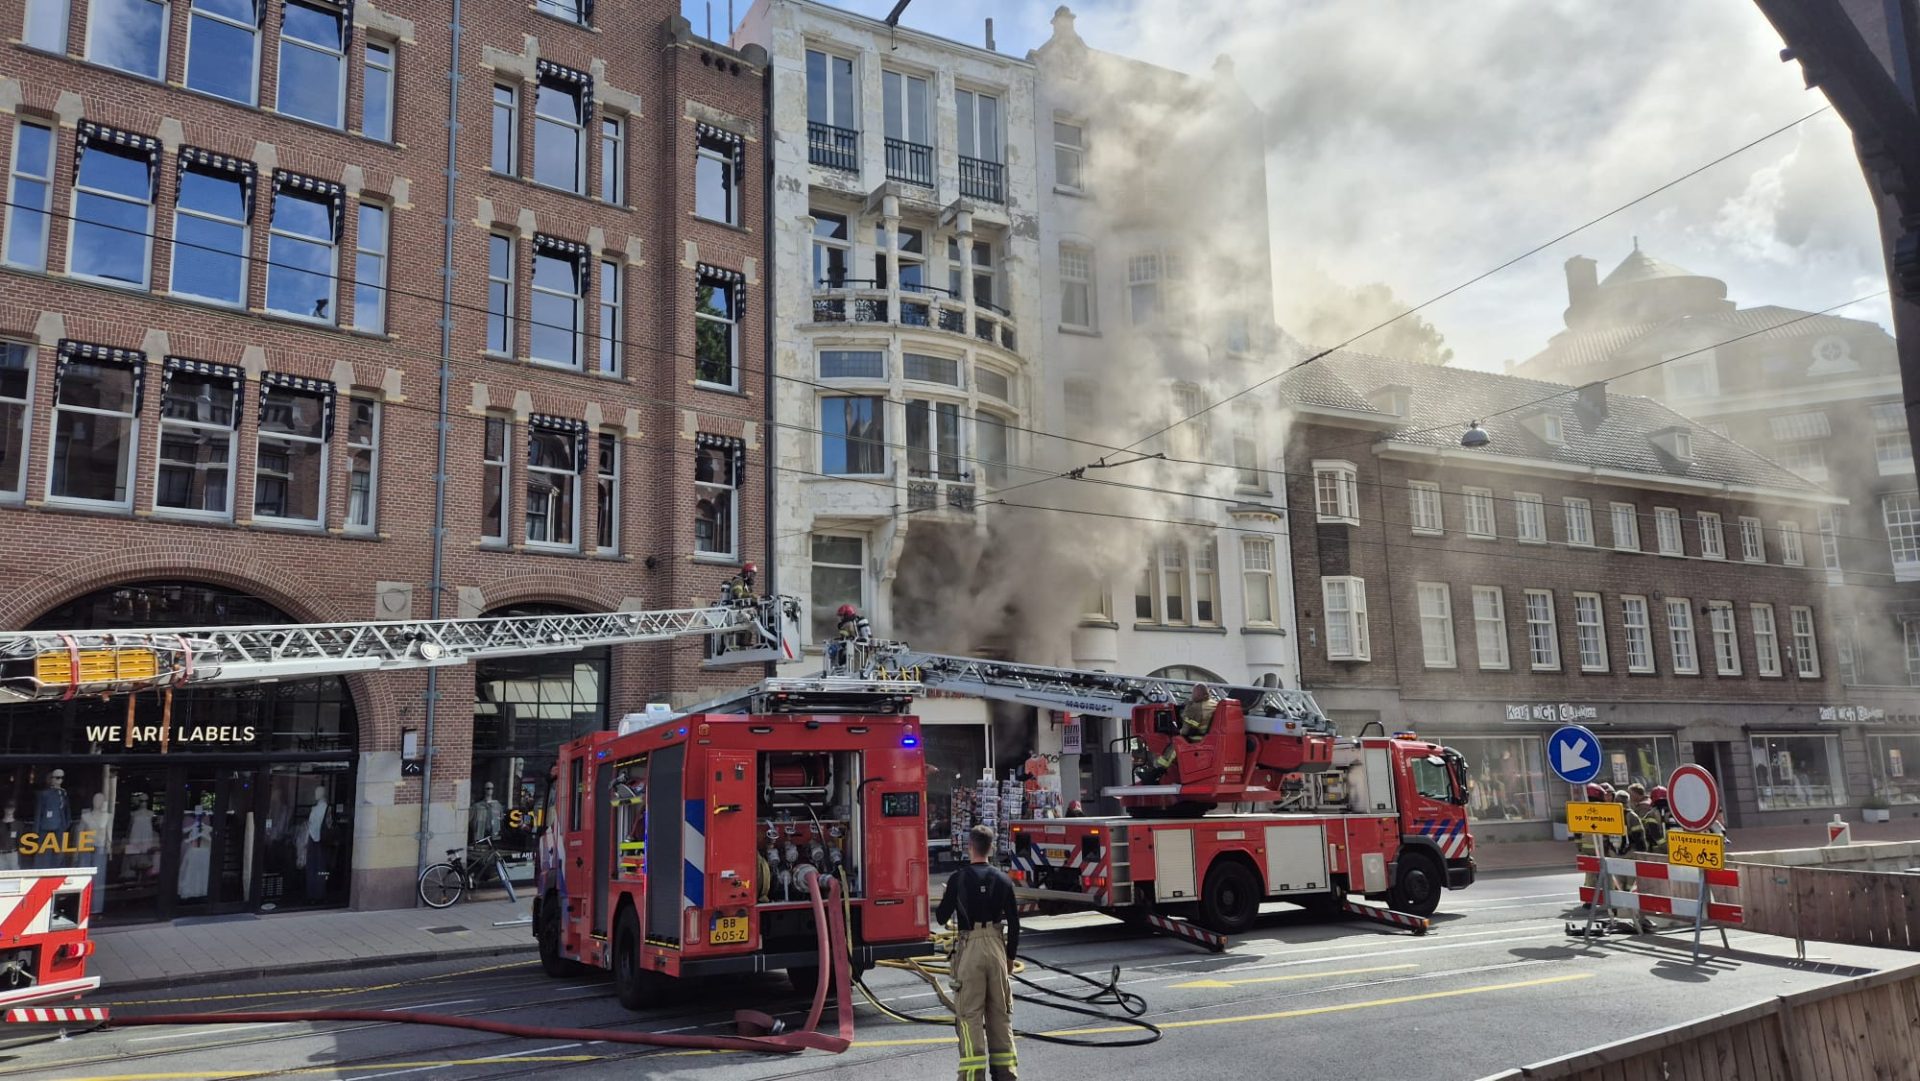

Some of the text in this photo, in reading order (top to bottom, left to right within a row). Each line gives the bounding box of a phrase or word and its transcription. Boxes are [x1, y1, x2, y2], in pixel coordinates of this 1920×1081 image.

[1065, 700, 1107, 711] MAGIRUS
[86, 726, 121, 742] WE
[178, 726, 255, 742] LABELS
[1584, 814, 1615, 822] trambaan
[18, 830, 97, 854] SALE
[1671, 835, 1719, 845] uitgezonderd
[723, 918, 736, 928] BB
[715, 930, 745, 941] 605-Z
